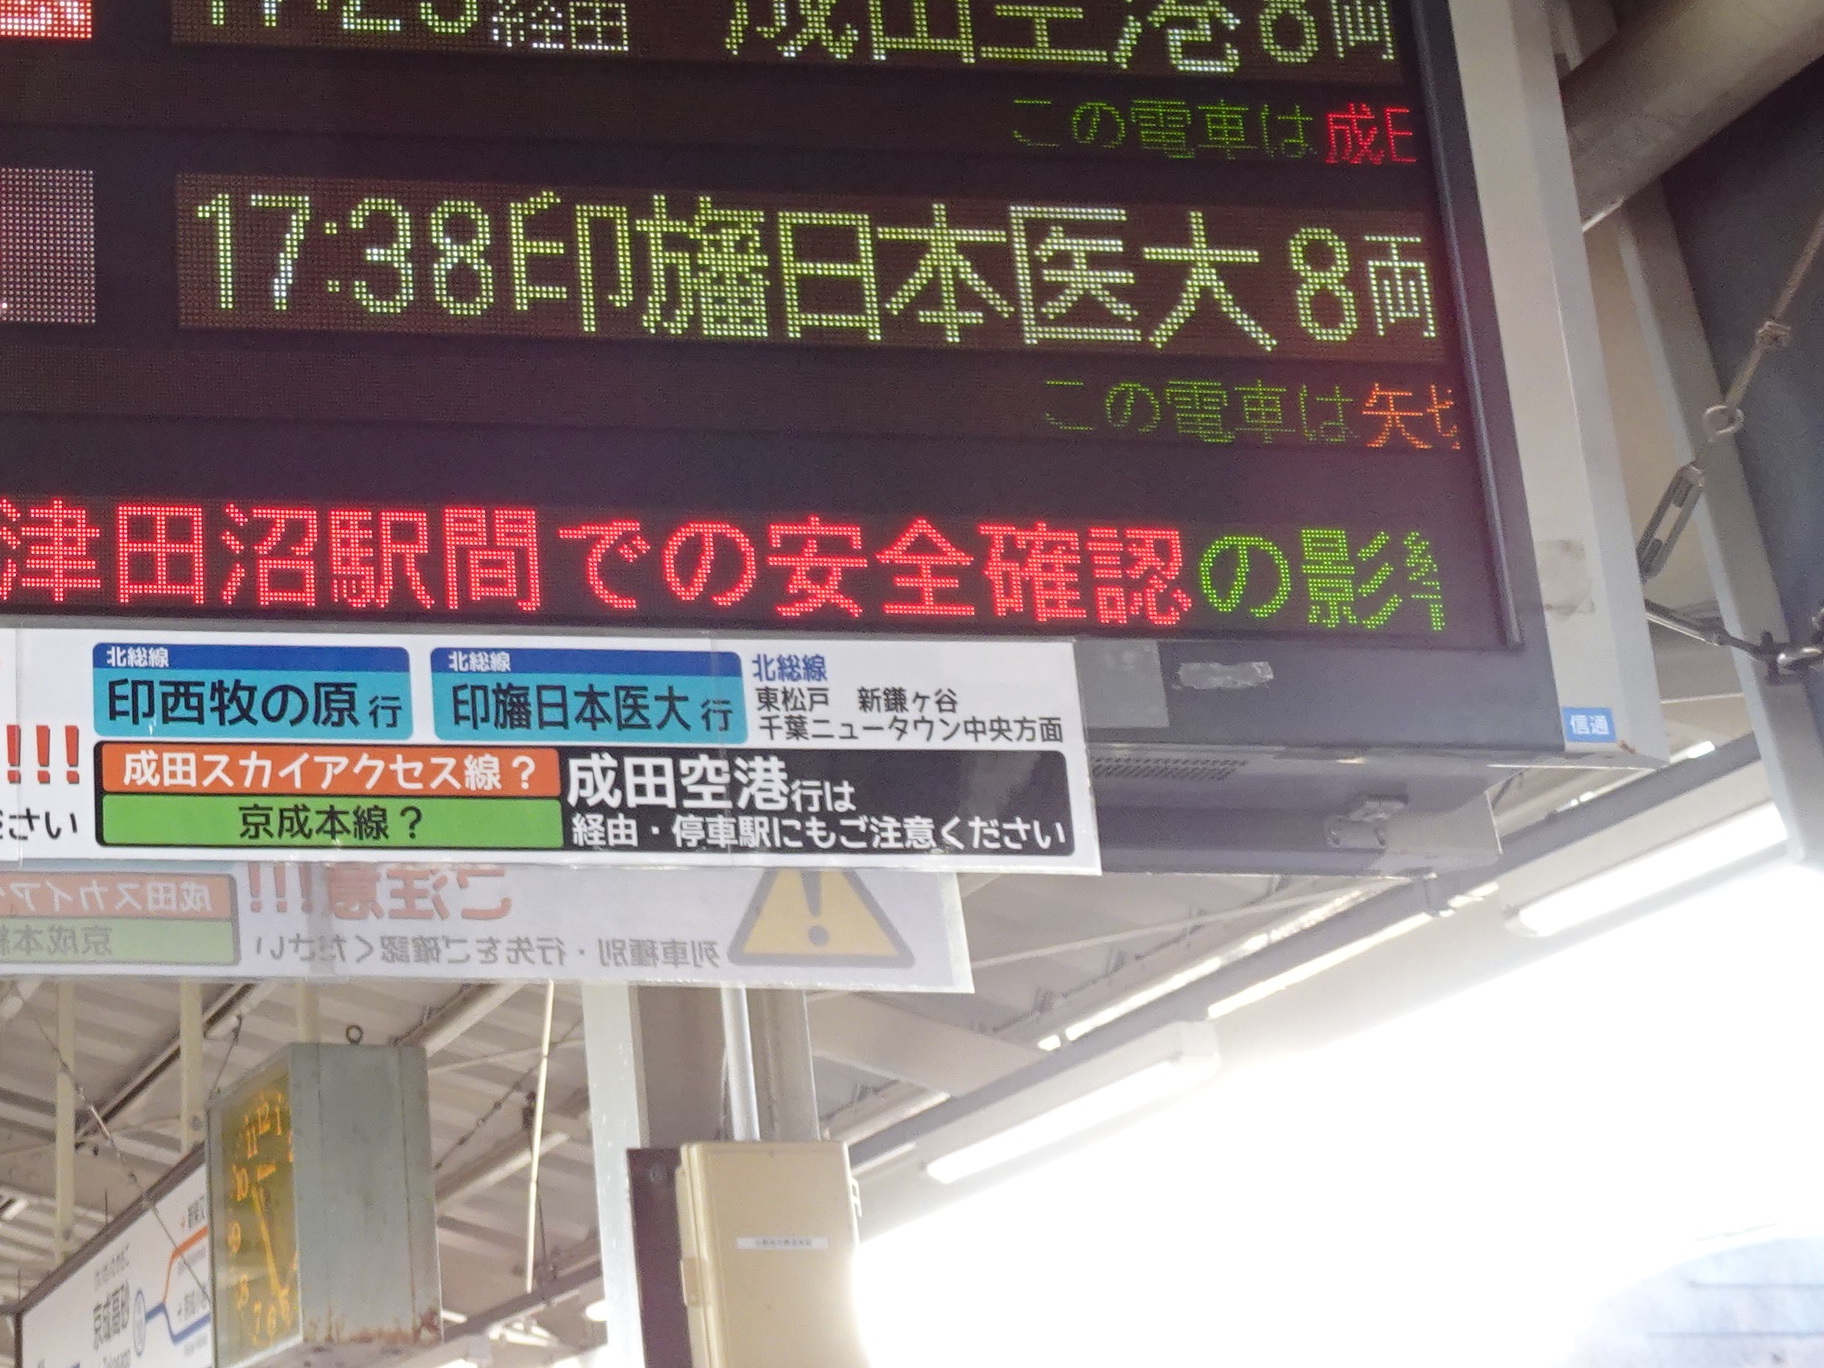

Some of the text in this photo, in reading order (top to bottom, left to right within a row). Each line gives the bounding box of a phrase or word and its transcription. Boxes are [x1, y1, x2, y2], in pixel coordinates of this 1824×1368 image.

[197, 193, 493, 316] 17:38
[106, 647, 169, 668] 北総線
[448, 650, 511, 673] 北総線
[751, 653, 827, 682] 北総線
[108, 679, 358, 728] 印西牧の原
[756, 686, 829, 713] 東松戸
[759, 715, 1063, 743] 千葉ニュータウン中央方面
[1570, 714, 1609, 734] 信通
[568, 754, 855, 813] 成田空港行は
[573, 814, 1066, 851] 経由・停車駅にもご注意ください
